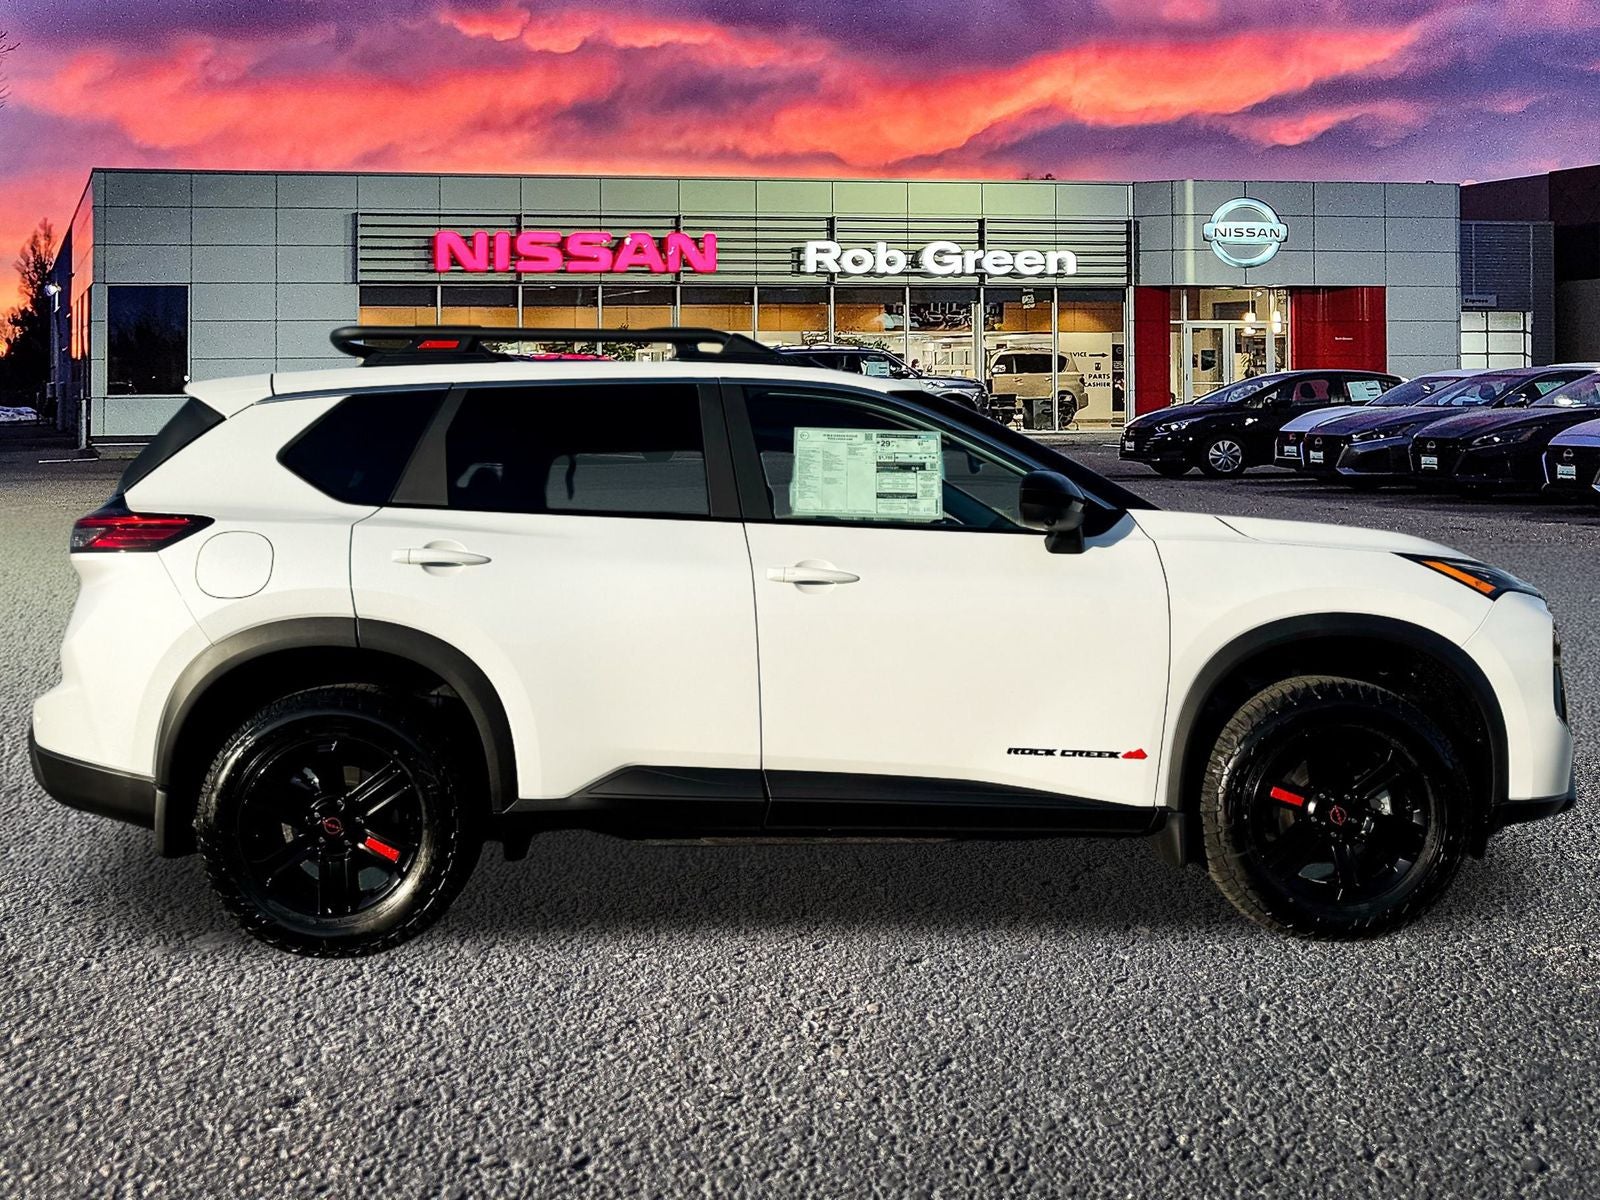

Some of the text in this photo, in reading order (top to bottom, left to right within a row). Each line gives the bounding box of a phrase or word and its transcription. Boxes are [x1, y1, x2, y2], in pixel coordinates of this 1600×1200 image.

[1214, 227, 1280, 238] NISSAN
[434, 231, 717, 273] NISSAN
[805, 241, 1077, 276] Rob Green
[1007, 748, 1121, 759] ROCK CREEK
